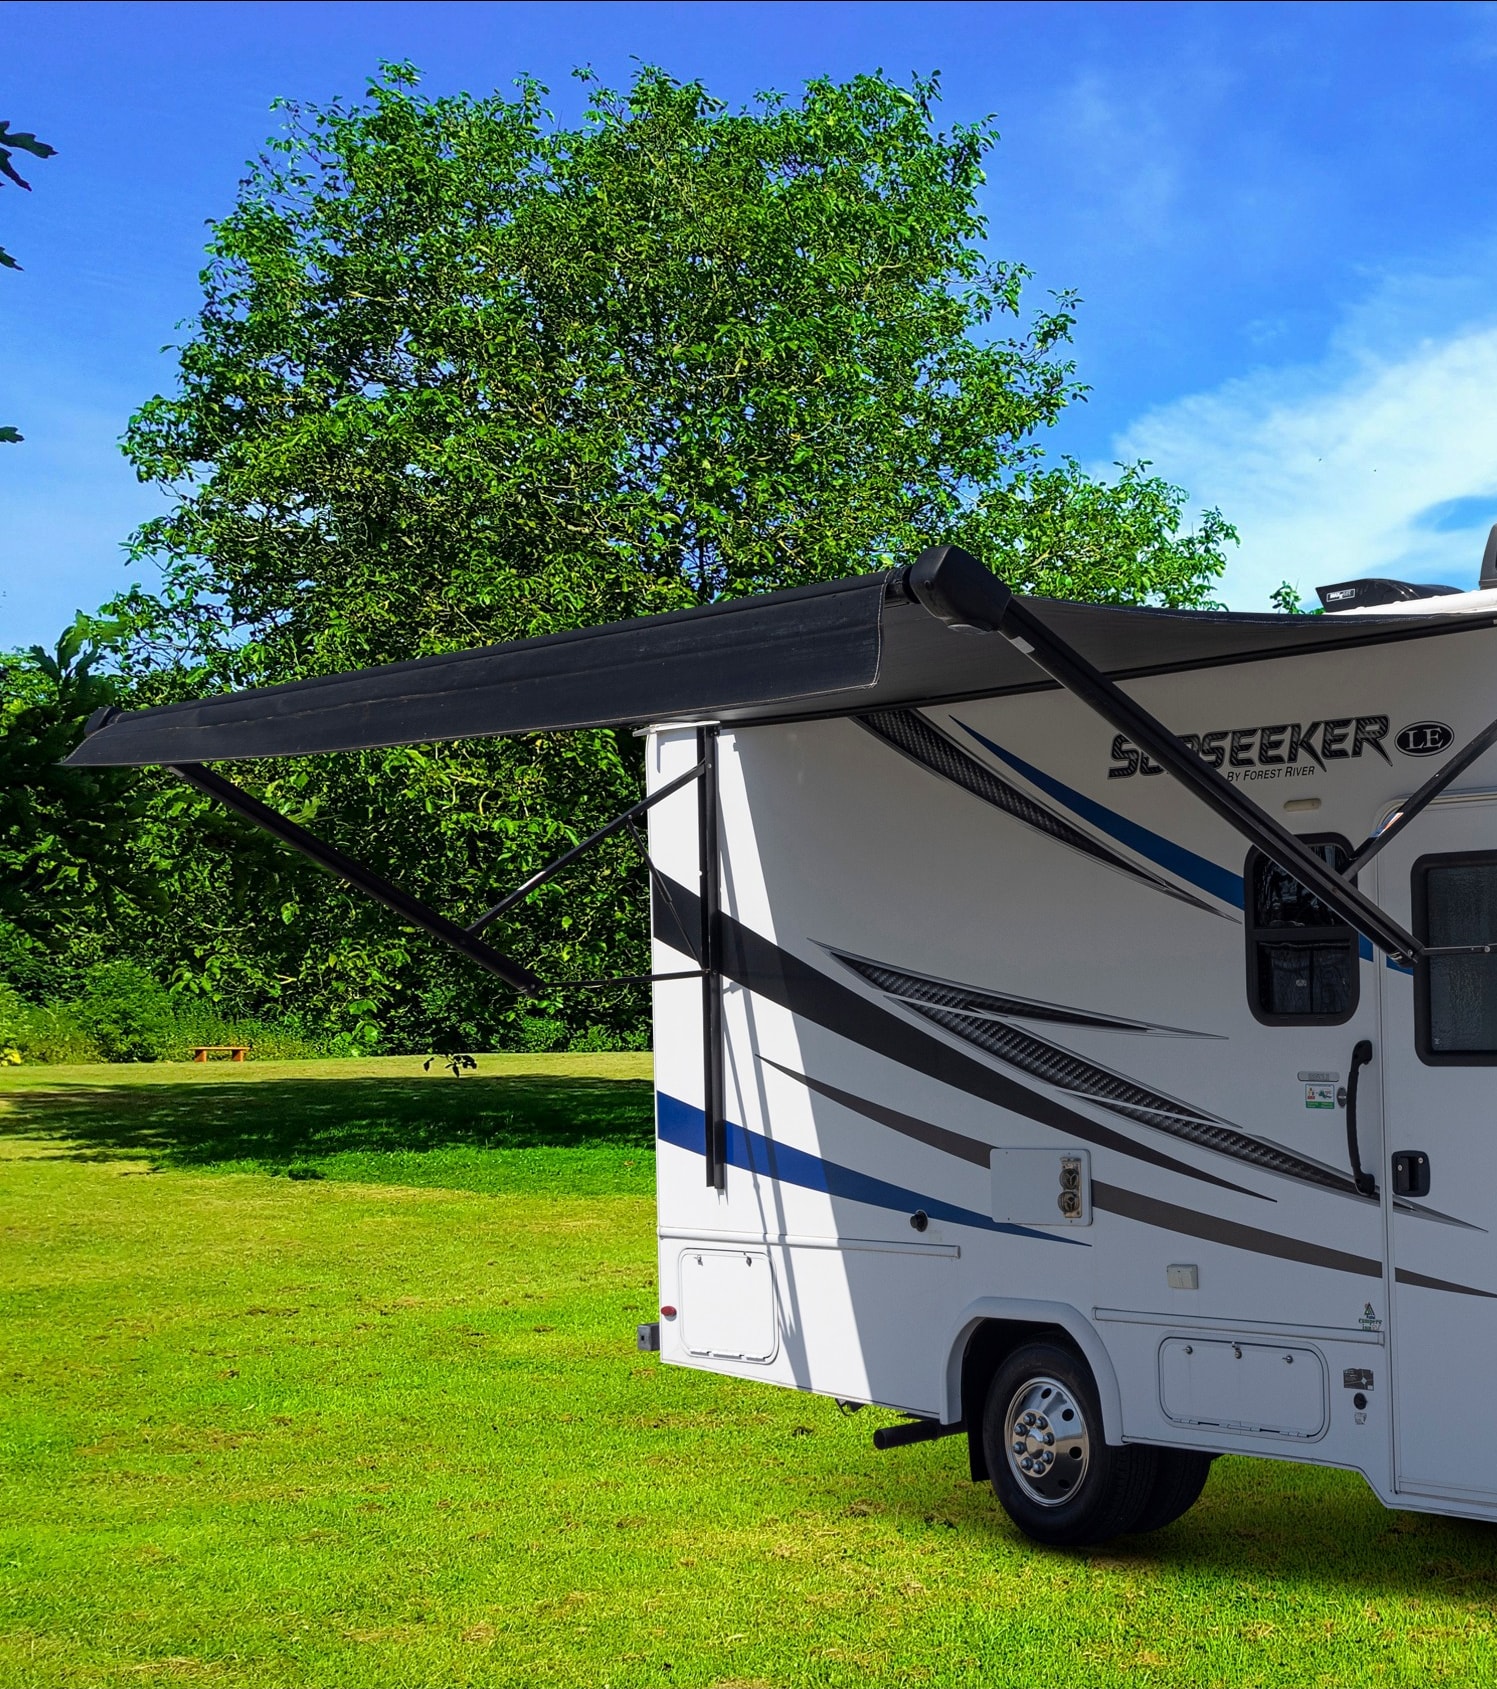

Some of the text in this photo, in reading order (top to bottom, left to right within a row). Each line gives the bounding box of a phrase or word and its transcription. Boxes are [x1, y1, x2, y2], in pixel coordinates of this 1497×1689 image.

[1405, 726, 1443, 751] LE
[1243, 767, 1282, 780] FOREST
[1284, 765, 1315, 777] RIVER
